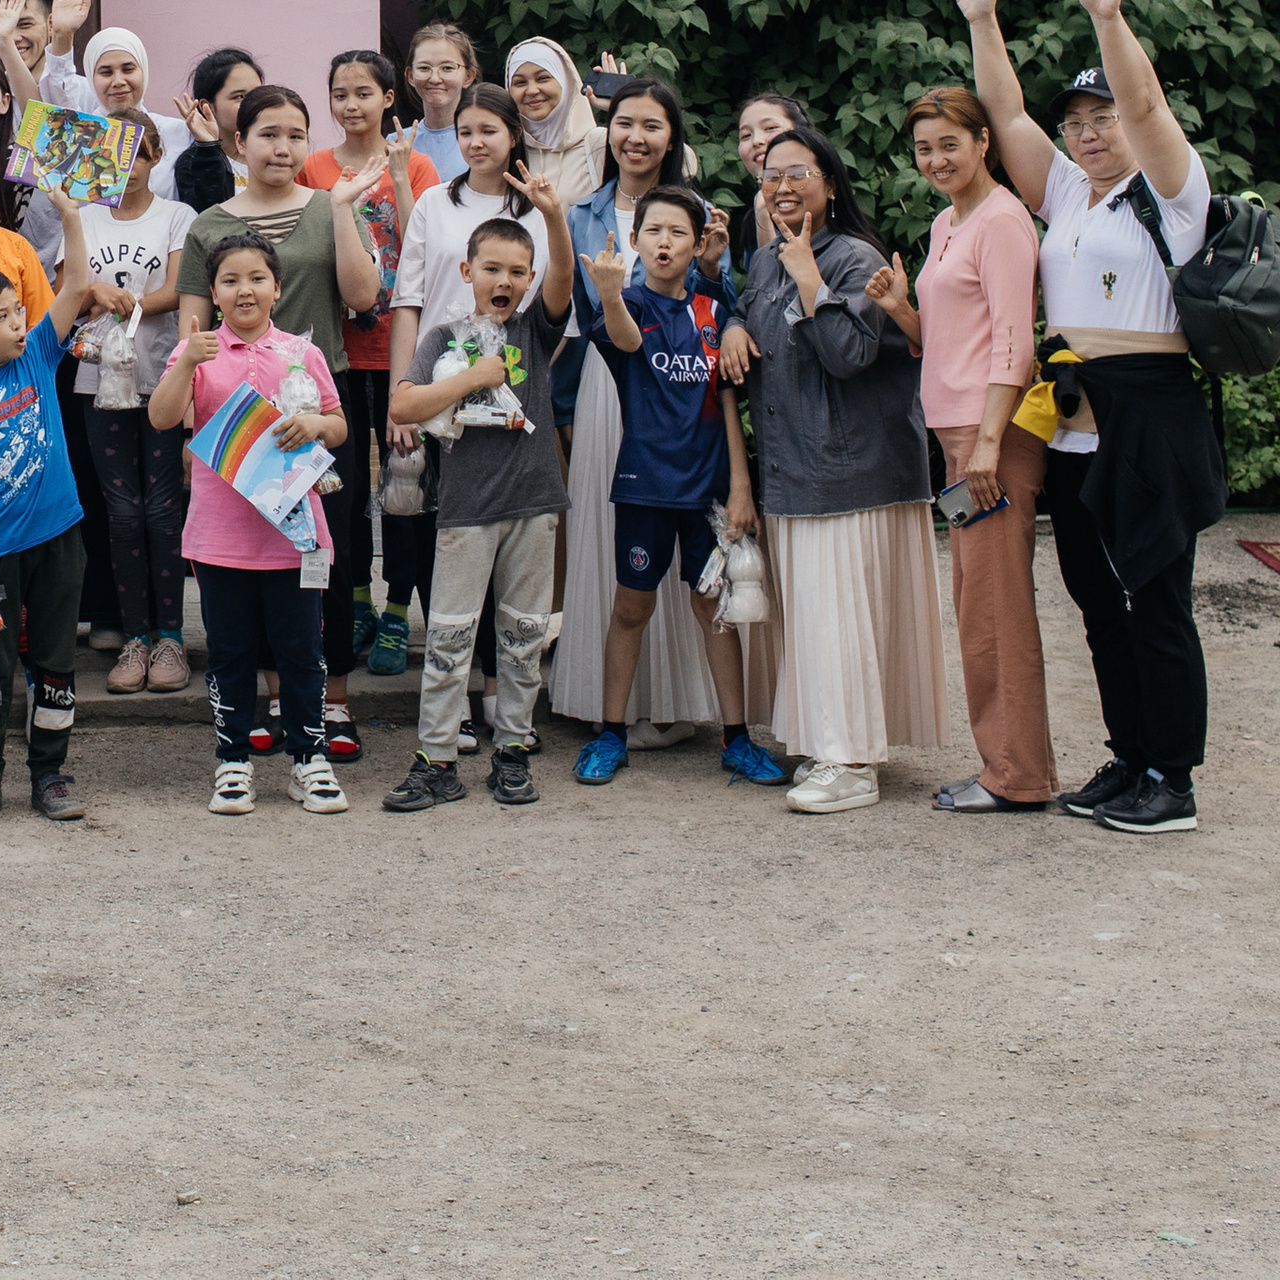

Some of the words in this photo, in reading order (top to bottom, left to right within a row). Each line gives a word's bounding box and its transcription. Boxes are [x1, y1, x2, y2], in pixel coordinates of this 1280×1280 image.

[89, 244, 162, 276] SUPER
[651, 352, 717, 374] QATAR
[669, 371, 712, 383] AIRWA
